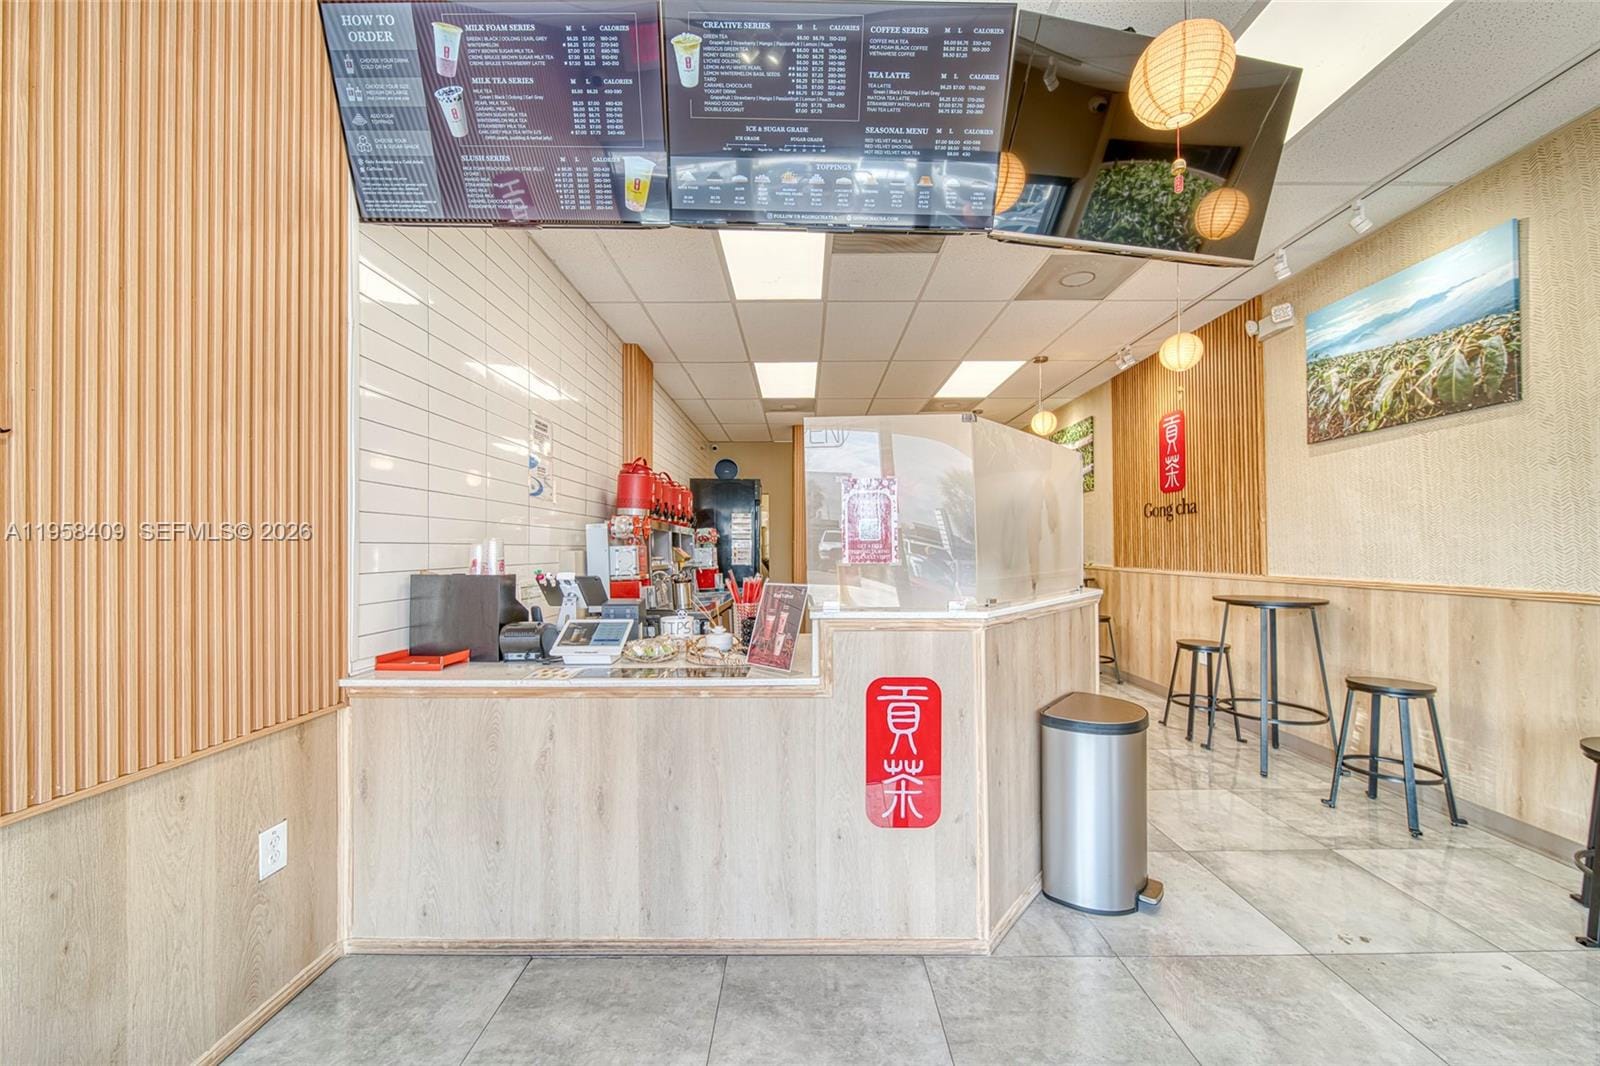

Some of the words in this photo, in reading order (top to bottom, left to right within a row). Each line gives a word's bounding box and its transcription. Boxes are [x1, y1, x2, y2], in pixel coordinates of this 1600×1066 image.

[340, 15, 373, 26] HOW
[376, 15, 395, 26] TO
[348, 31, 394, 42] ORDER
[1163, 414, 1180, 488] 貢茶
[1144, 502, 1174, 522] Gong
[1176, 498, 1197, 516] cha
[662, 621, 691, 635] TIPS
[877, 685, 929, 818] 貢茶
